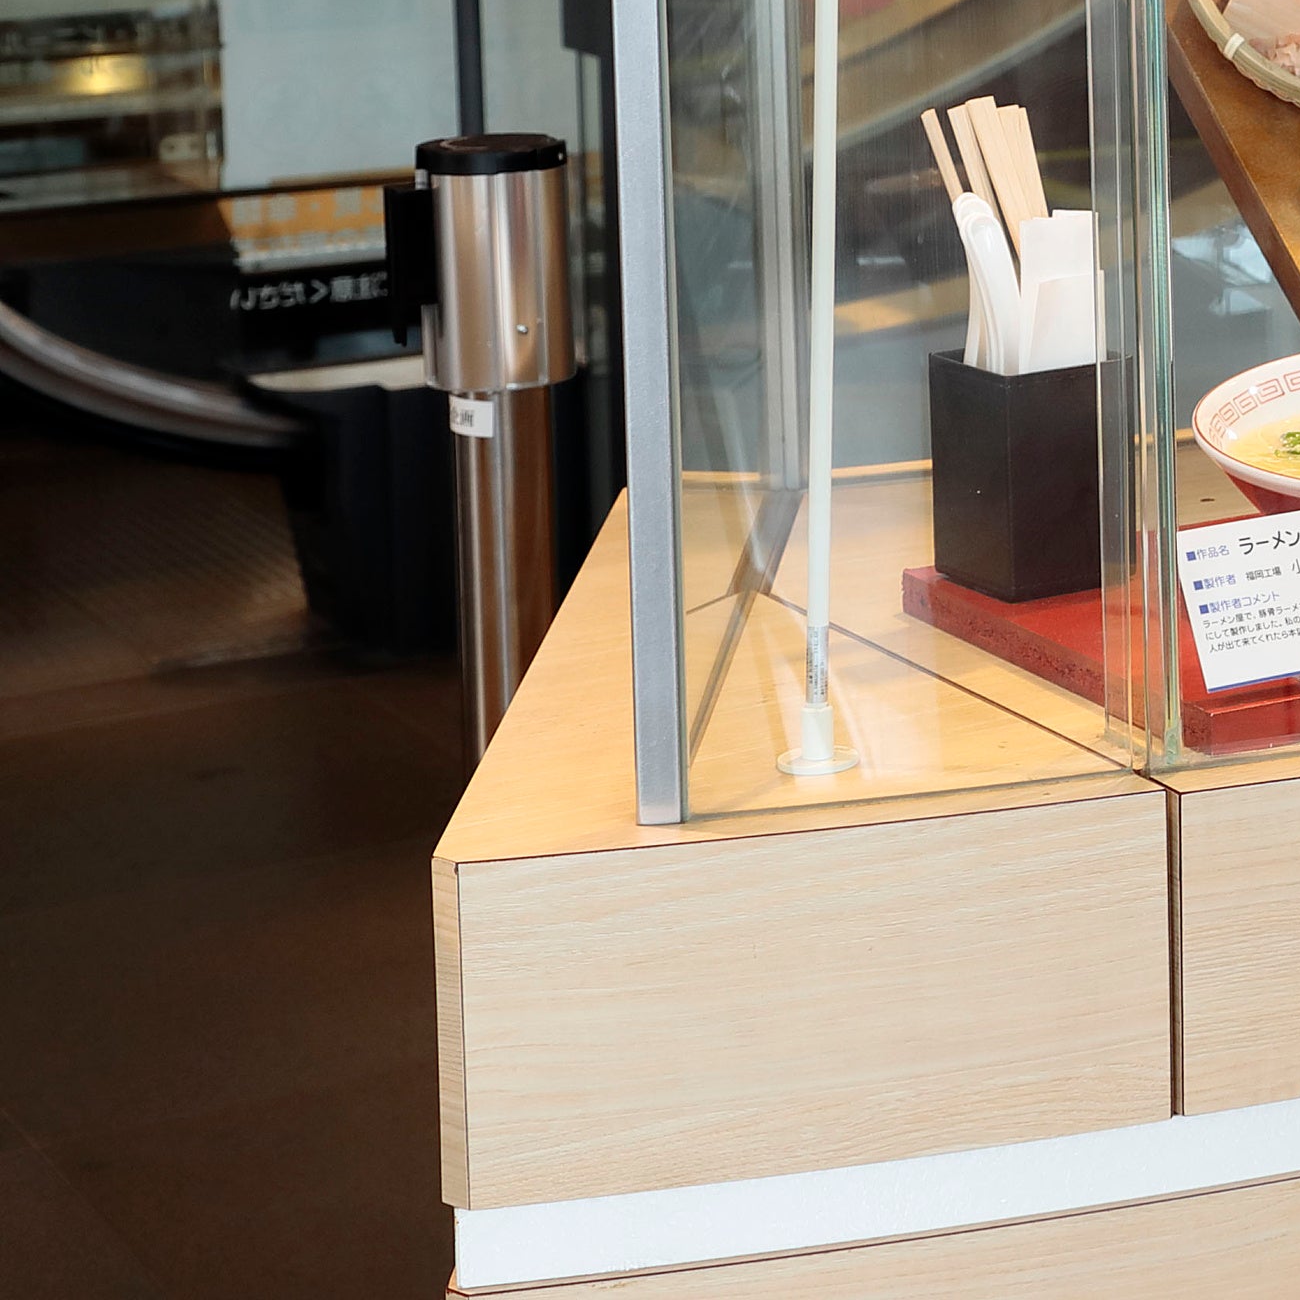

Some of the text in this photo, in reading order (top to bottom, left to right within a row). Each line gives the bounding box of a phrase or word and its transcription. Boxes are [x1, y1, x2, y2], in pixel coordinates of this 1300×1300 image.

[1196, 544, 1230, 561] 作品名
[1204, 574, 1236, 589] 製作者
[1245, 566, 1282, 581] 福岡工場
[1208, 589, 1280, 613] 製作者コメント
